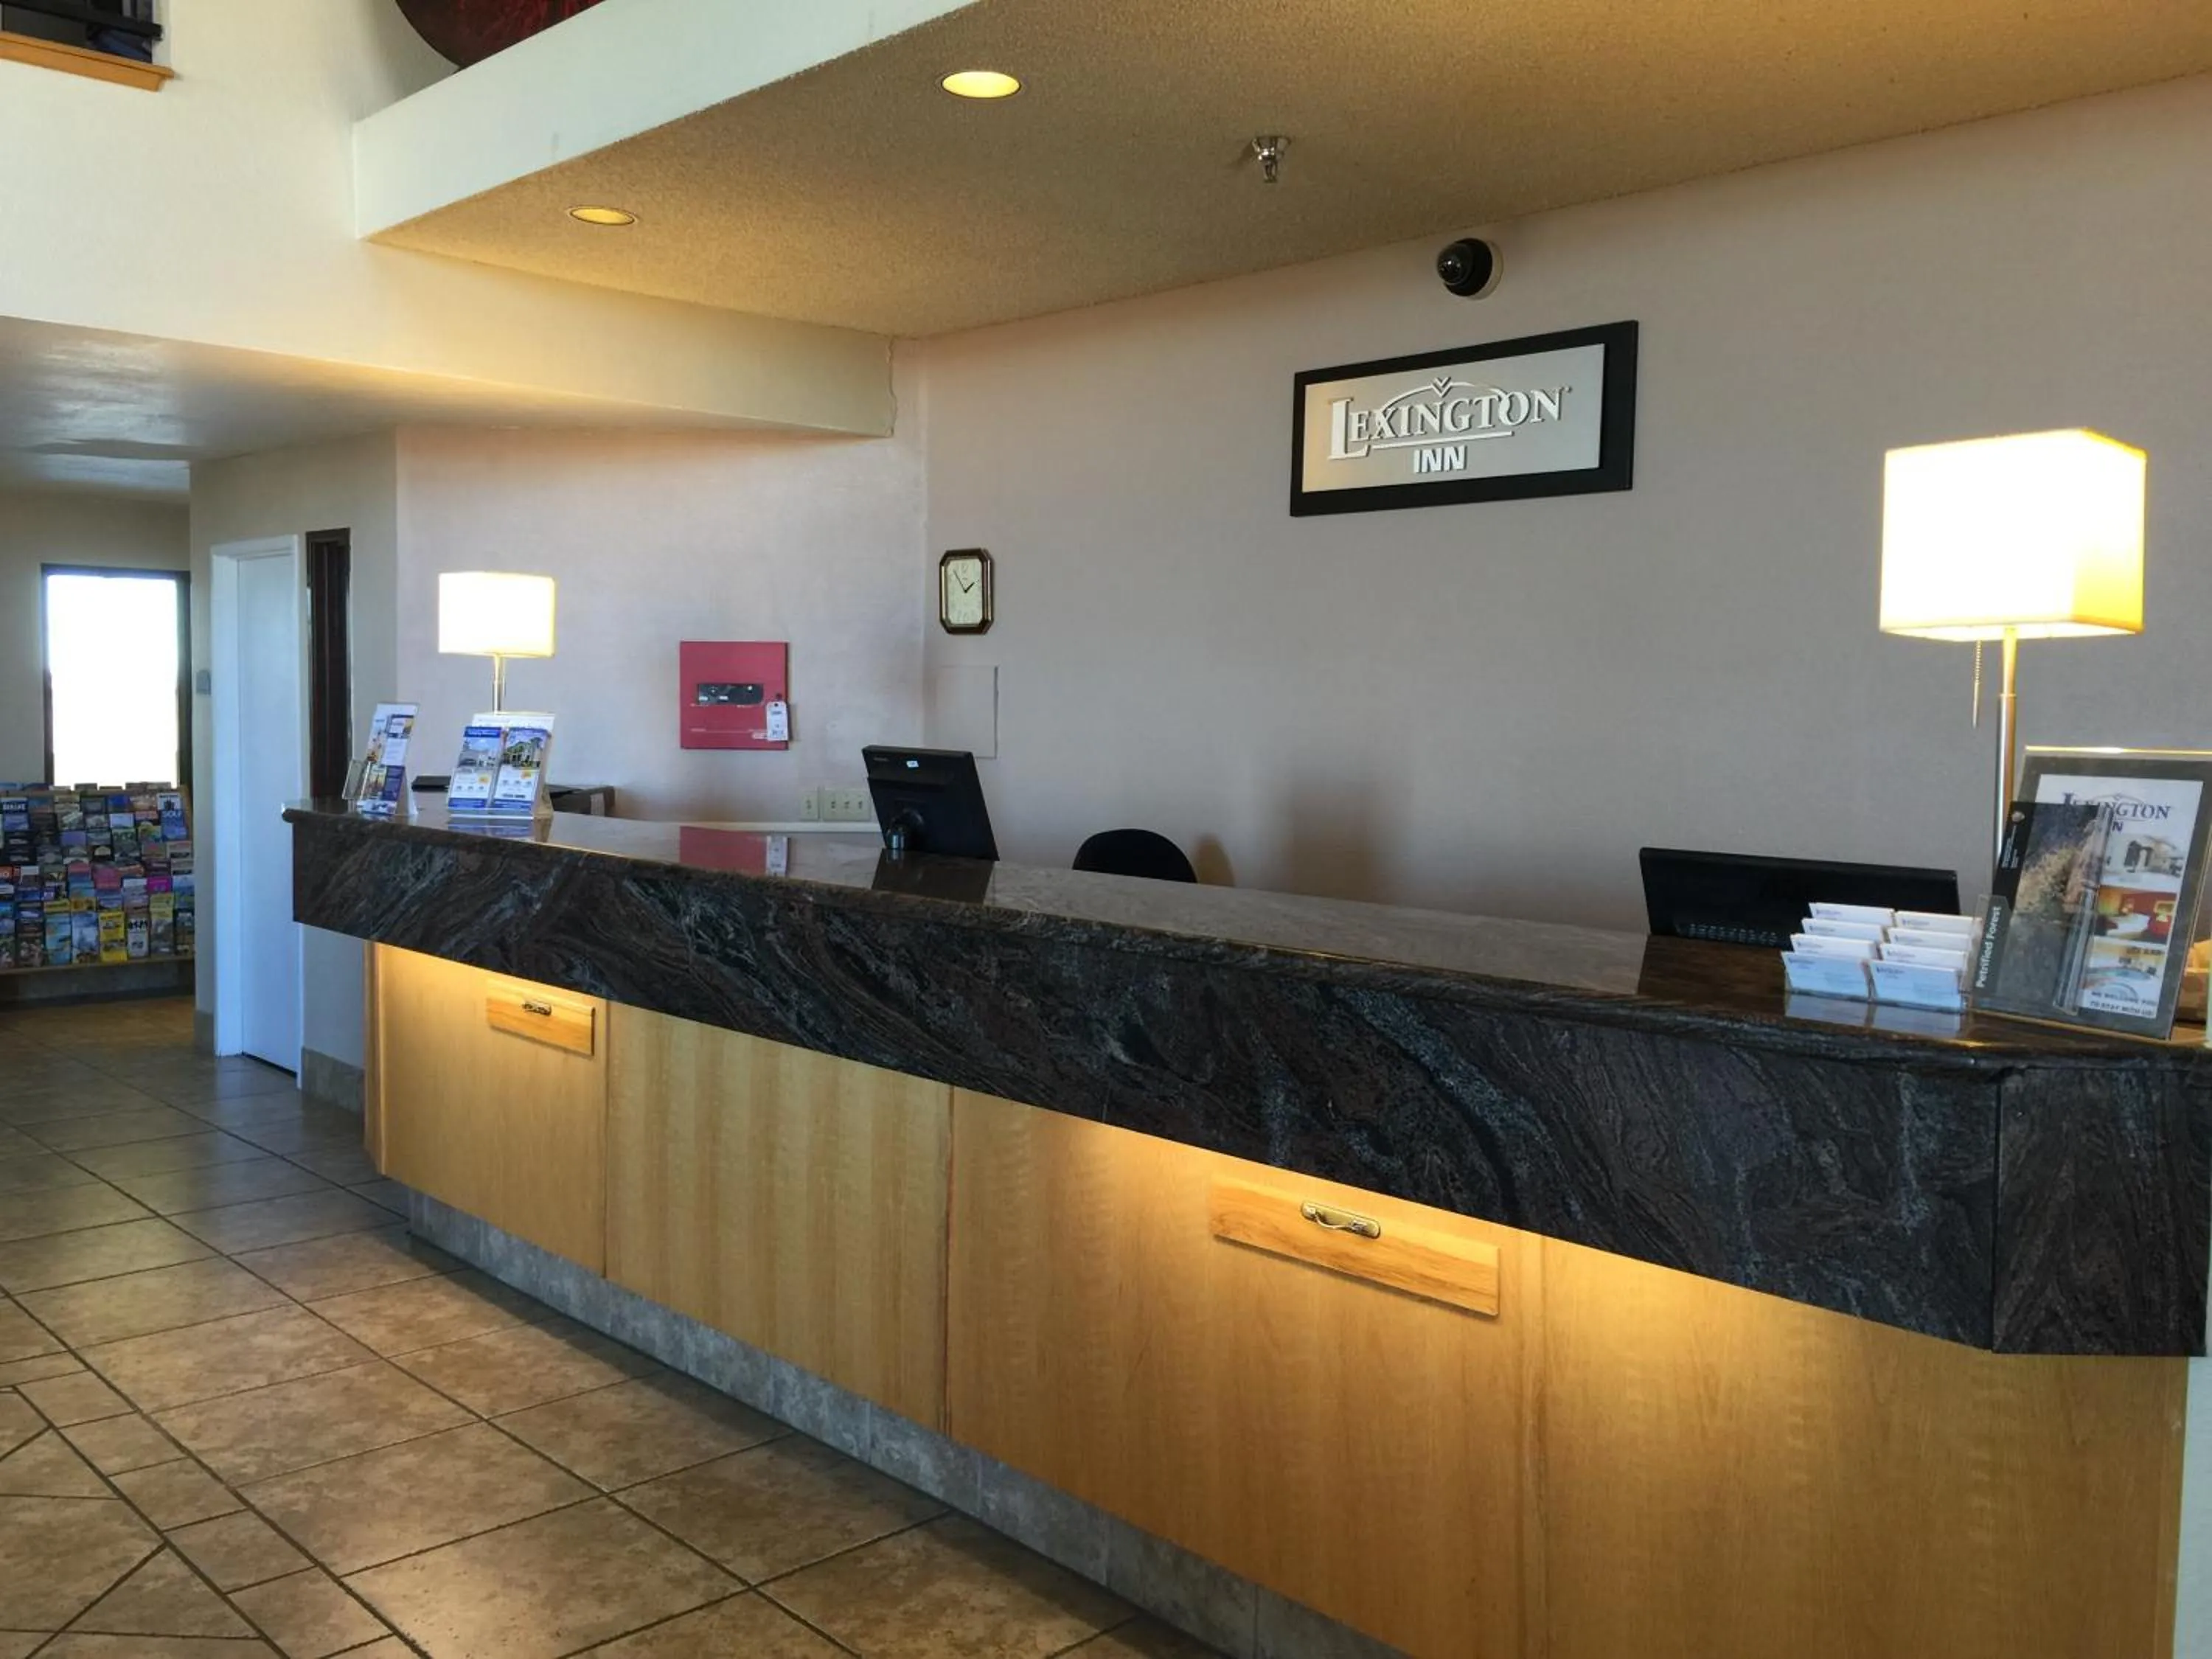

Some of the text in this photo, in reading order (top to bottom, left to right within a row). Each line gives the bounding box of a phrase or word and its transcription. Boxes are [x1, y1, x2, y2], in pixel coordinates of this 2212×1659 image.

[1328, 386, 1565, 459] LEXINGTON
[1413, 445, 1467, 473] INN
[1975, 905, 2002, 988] Petrified Forest
